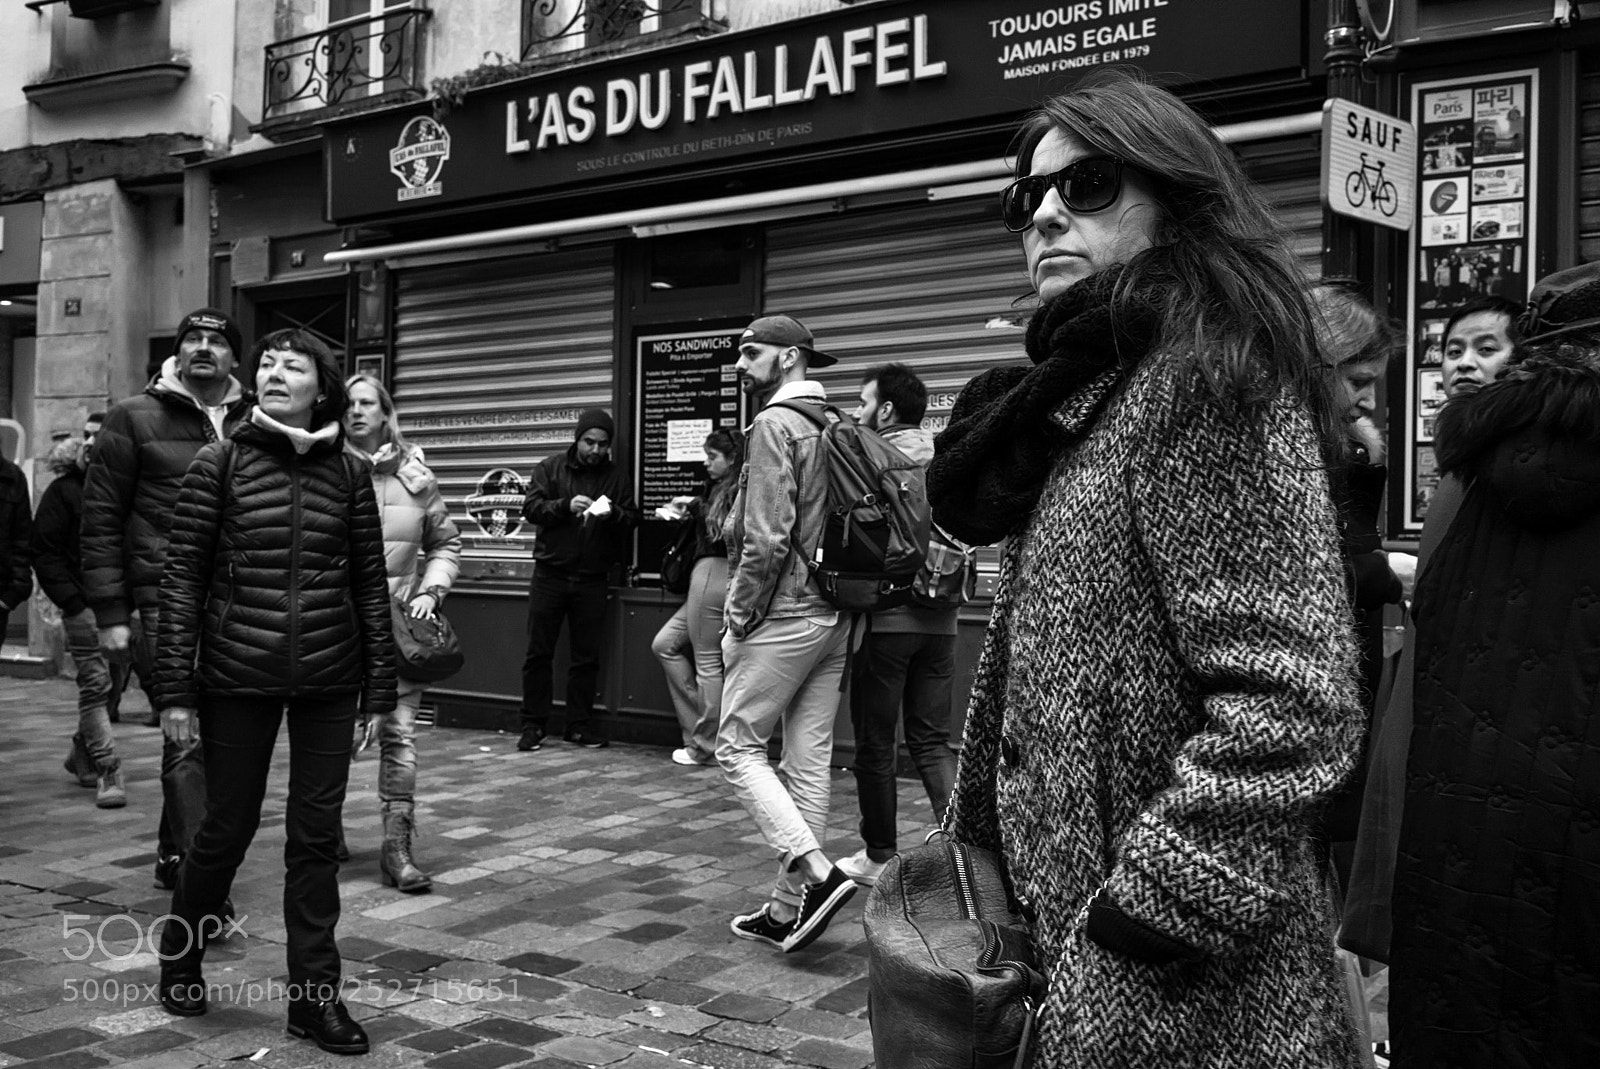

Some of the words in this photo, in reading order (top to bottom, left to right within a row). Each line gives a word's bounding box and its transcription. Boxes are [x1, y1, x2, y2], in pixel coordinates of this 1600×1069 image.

[988, 0, 1102, 38] TOUJOURS
[605, 70, 672, 138] DU
[683, 14, 948, 123] FALLAFEL
[1003, 62, 1050, 80] MAISON
[1051, 53, 1101, 71] FONDEE
[1102, 50, 1120, 63] EN
[1123, 44, 1151, 59] 1979
[506, 84, 597, 154] JAMAIS
[1082, 17, 1157, 48] EGALE
[1477, 86, 1514, 108] 파리
[1433, 101, 1463, 115] Paris
[576, 157, 604, 172] SOUS
[606, 152, 621, 166] LE
[622, 143, 681, 163] CONTROLE
[682, 141, 700, 154] DU
[757, 130, 774, 142] DE
[776, 121, 814, 138] PARIS
[1346, 112, 1402, 152] SAUF
[653, 341, 673, 353] NOS
[675, 337, 732, 352] SANDWICHS
[930, 394, 955, 407] LES
